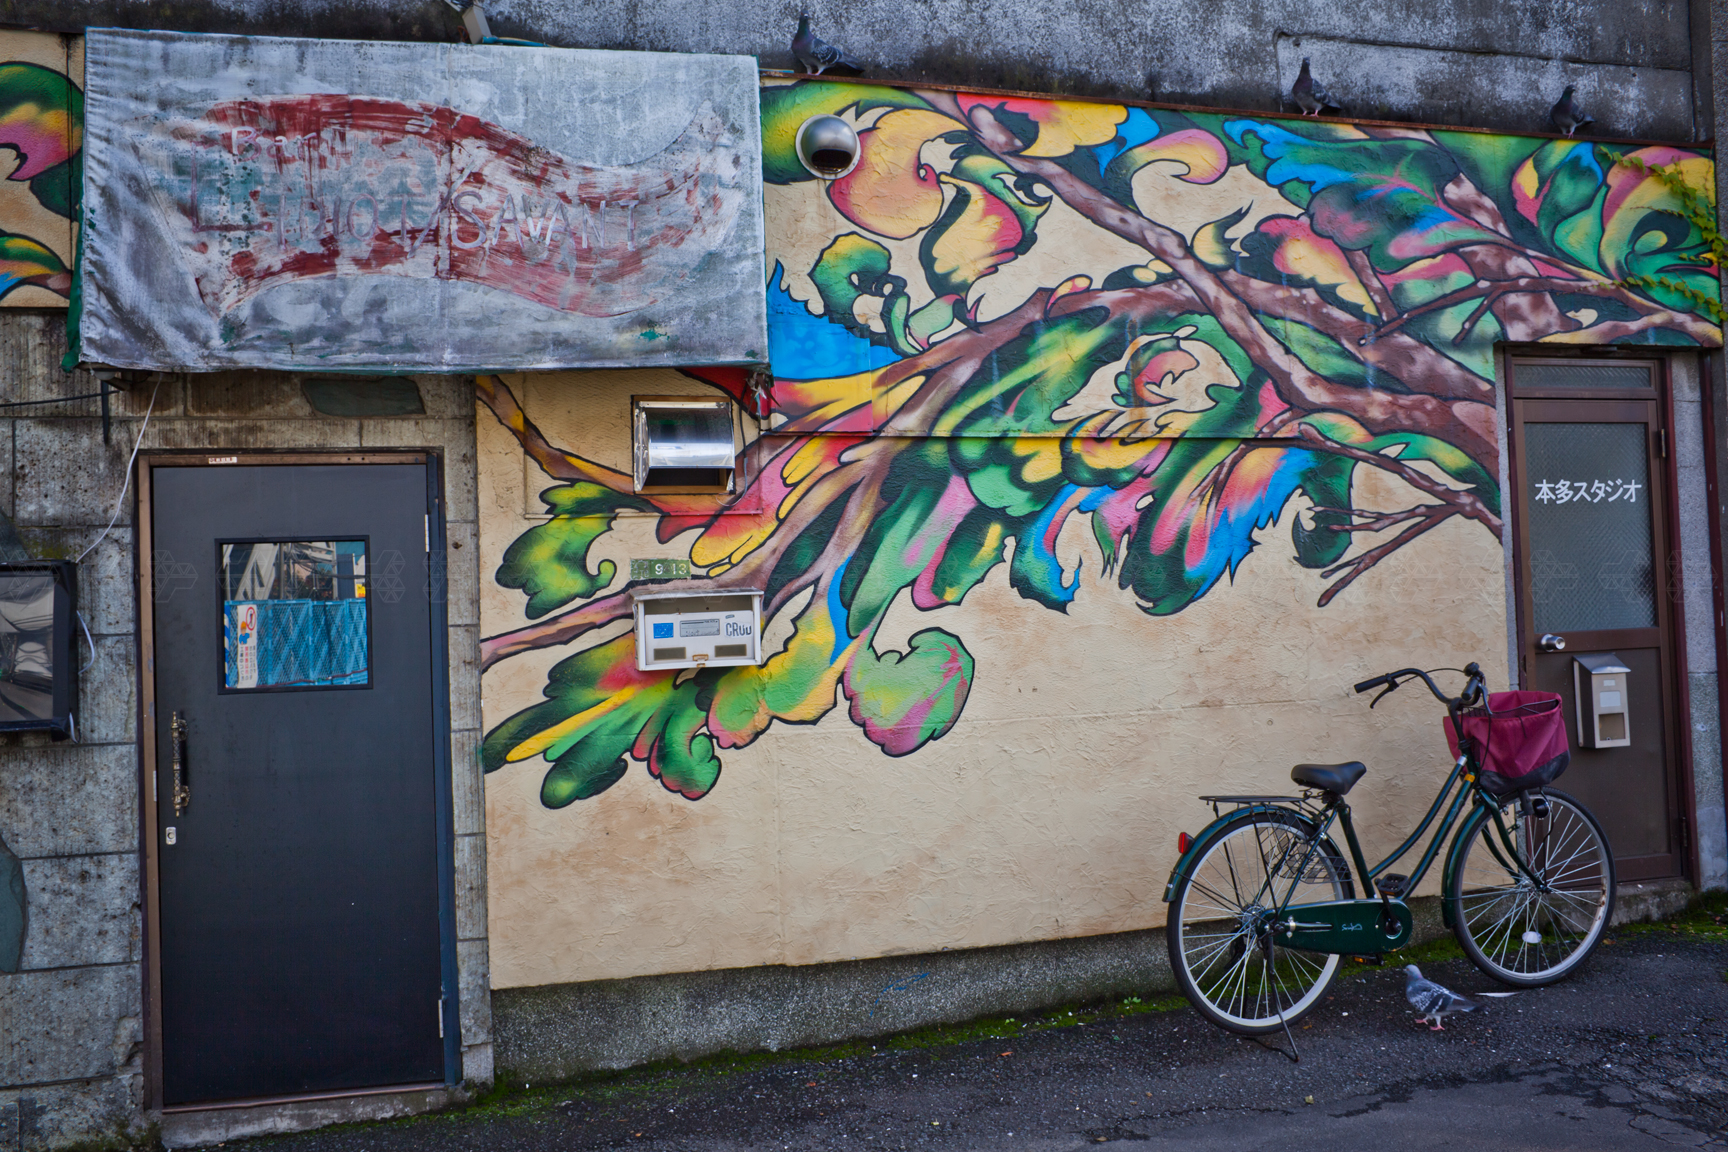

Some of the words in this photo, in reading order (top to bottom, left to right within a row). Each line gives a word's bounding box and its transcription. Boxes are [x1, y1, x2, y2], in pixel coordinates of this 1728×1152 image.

[230, 125, 317, 164] Bar
[1535, 479, 1642, 505] 本多スタジオ
